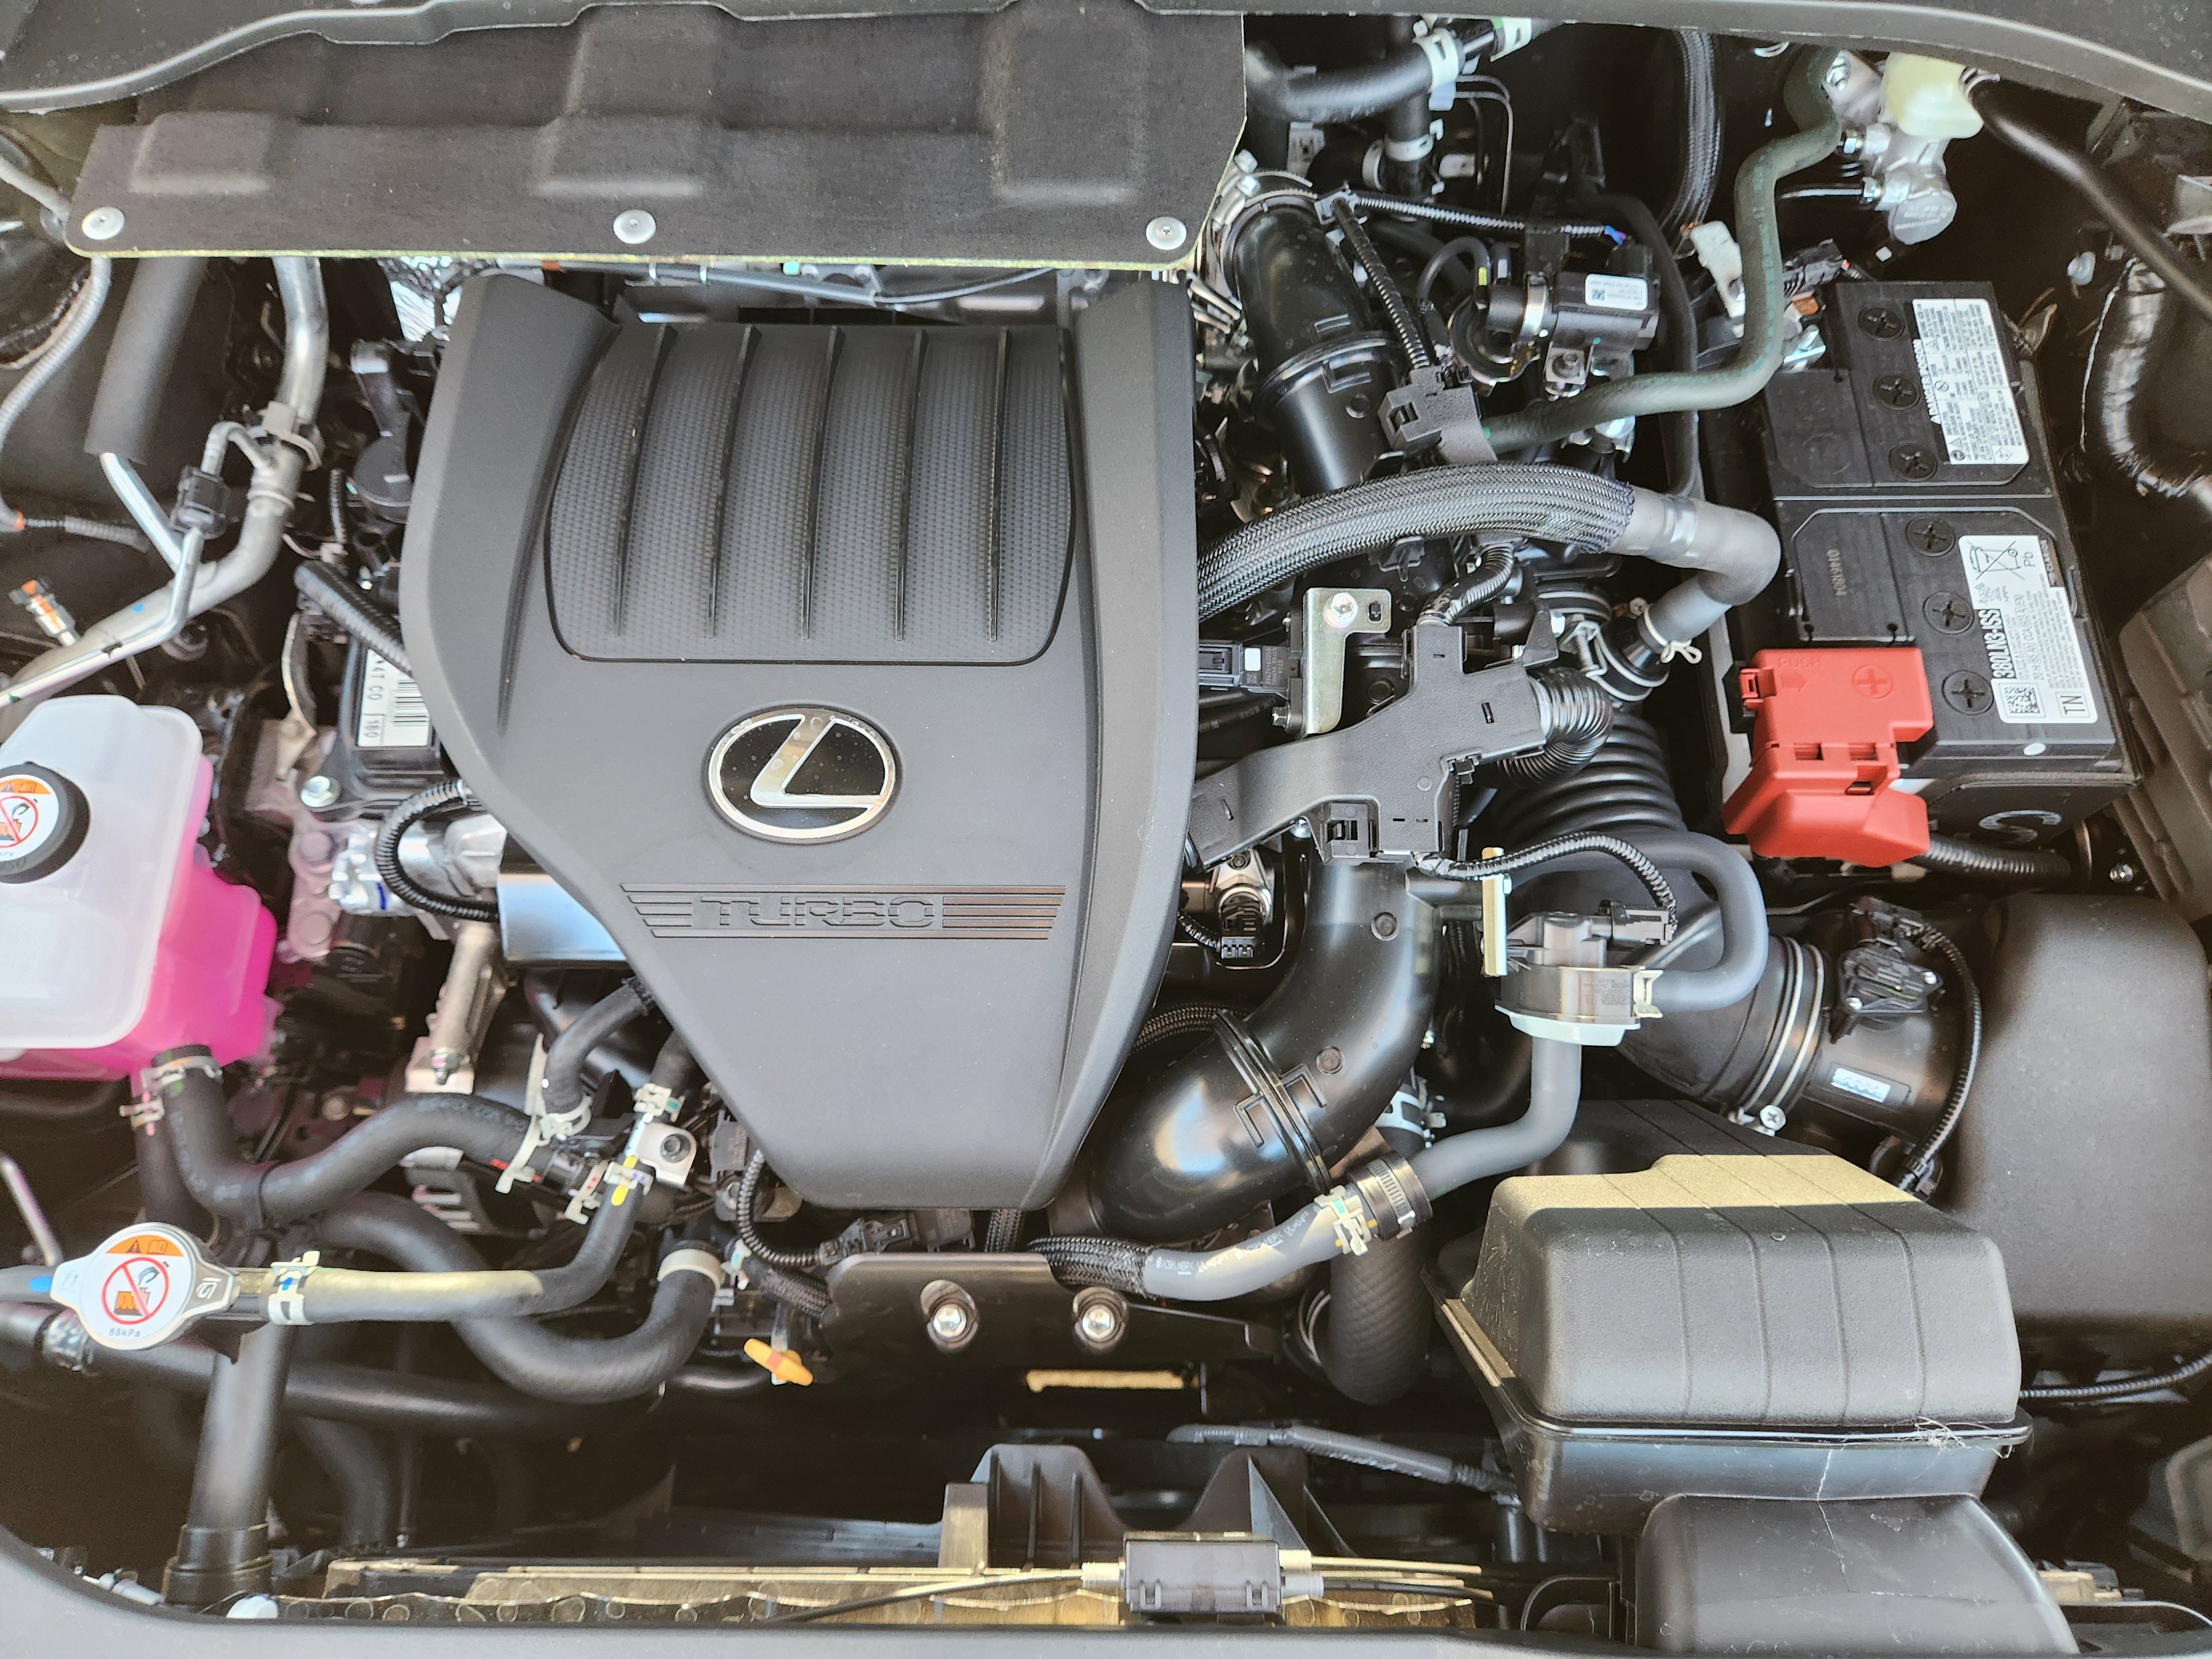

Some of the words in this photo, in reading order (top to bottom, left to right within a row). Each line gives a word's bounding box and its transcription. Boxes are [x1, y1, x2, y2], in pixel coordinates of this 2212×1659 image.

[2023, 552, 2036, 568] Pb
[1978, 609, 2015, 679] 380LN3-ISS
[1777, 657, 1821, 669] PUSH
[2060, 695, 2086, 714] TN
[700, 895, 935, 928] TURBO
[108, 1328, 141, 1339] 88kPa
